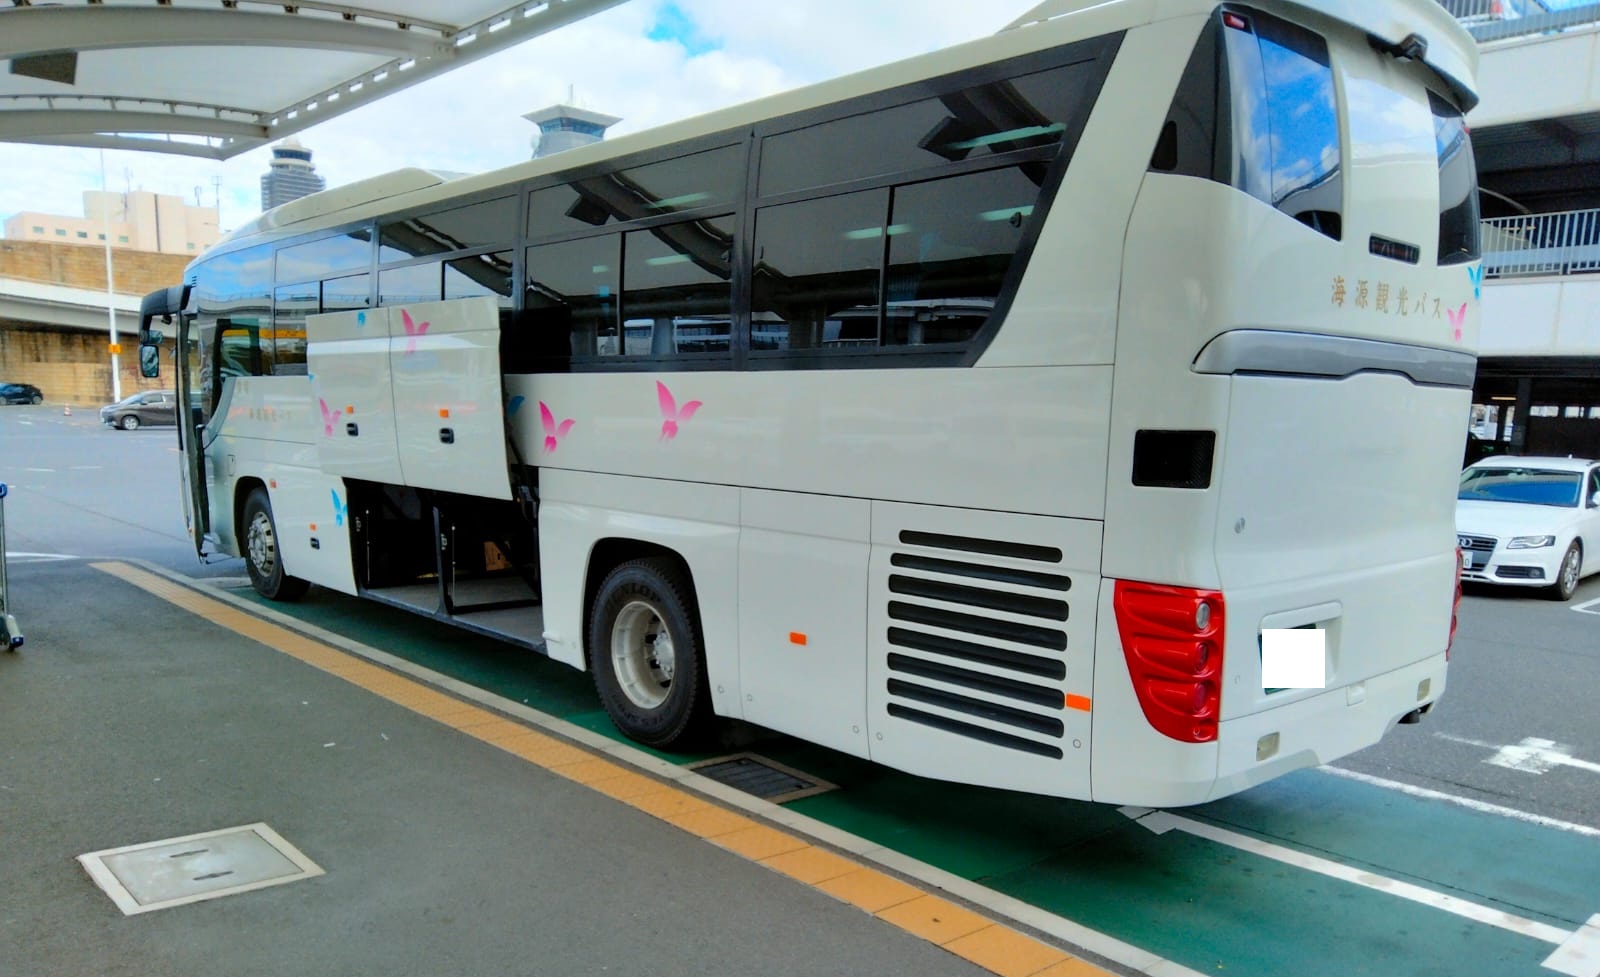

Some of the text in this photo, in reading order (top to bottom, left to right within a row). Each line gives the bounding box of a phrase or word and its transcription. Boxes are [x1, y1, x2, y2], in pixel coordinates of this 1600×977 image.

[1331, 275, 1442, 319] 海源観光バス
